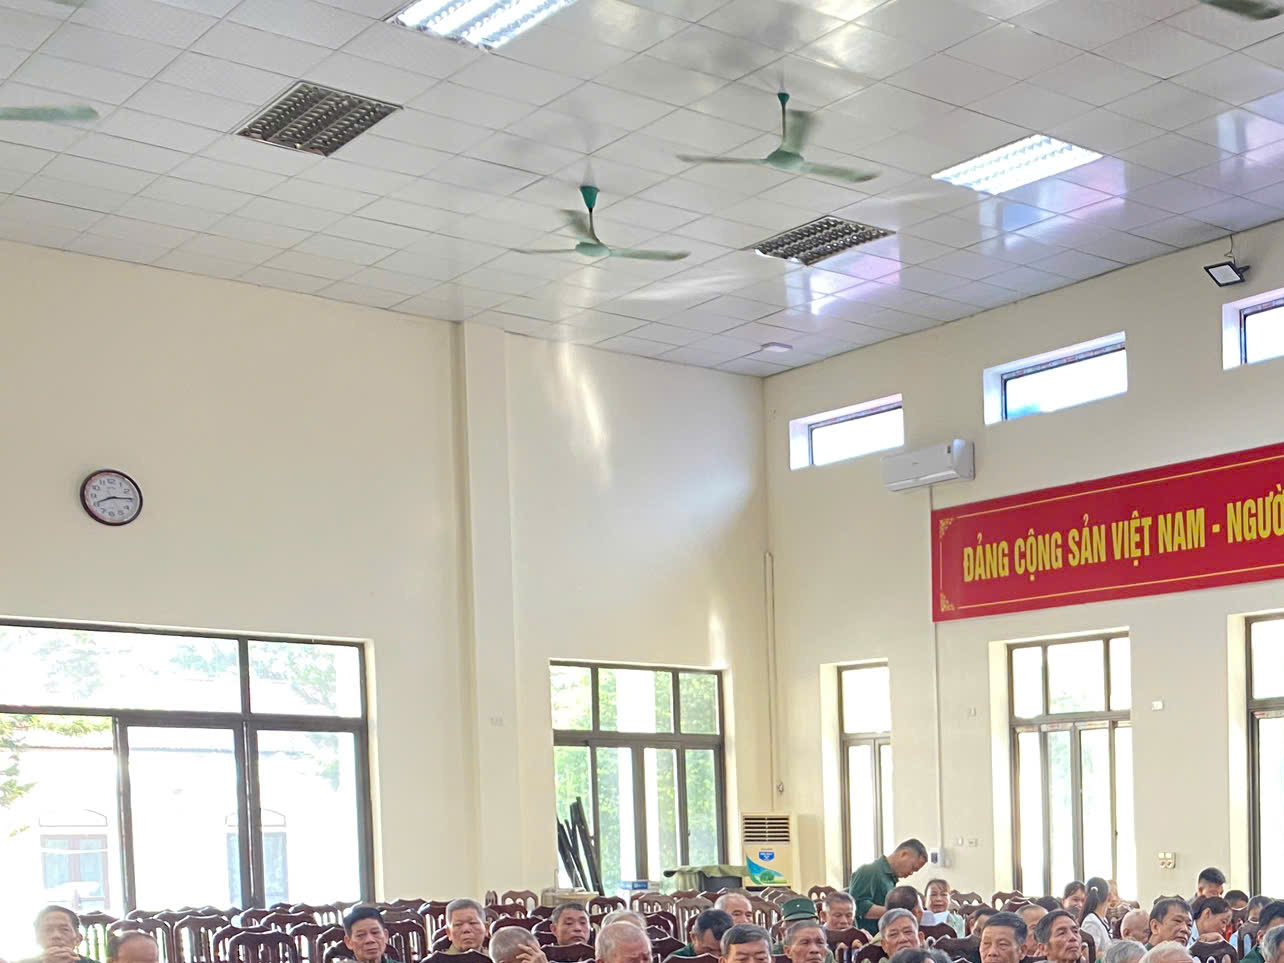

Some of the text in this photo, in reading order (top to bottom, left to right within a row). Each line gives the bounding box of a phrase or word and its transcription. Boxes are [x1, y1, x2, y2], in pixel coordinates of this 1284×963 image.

[963, 532, 1010, 583] ĐẢNG
[1014, 528, 1063, 581] CỘNG
[1067, 513, 1107, 567] SẢN
[1111, 510, 1153, 566] VIỆT
[1158, 507, 1206, 553] NAM
